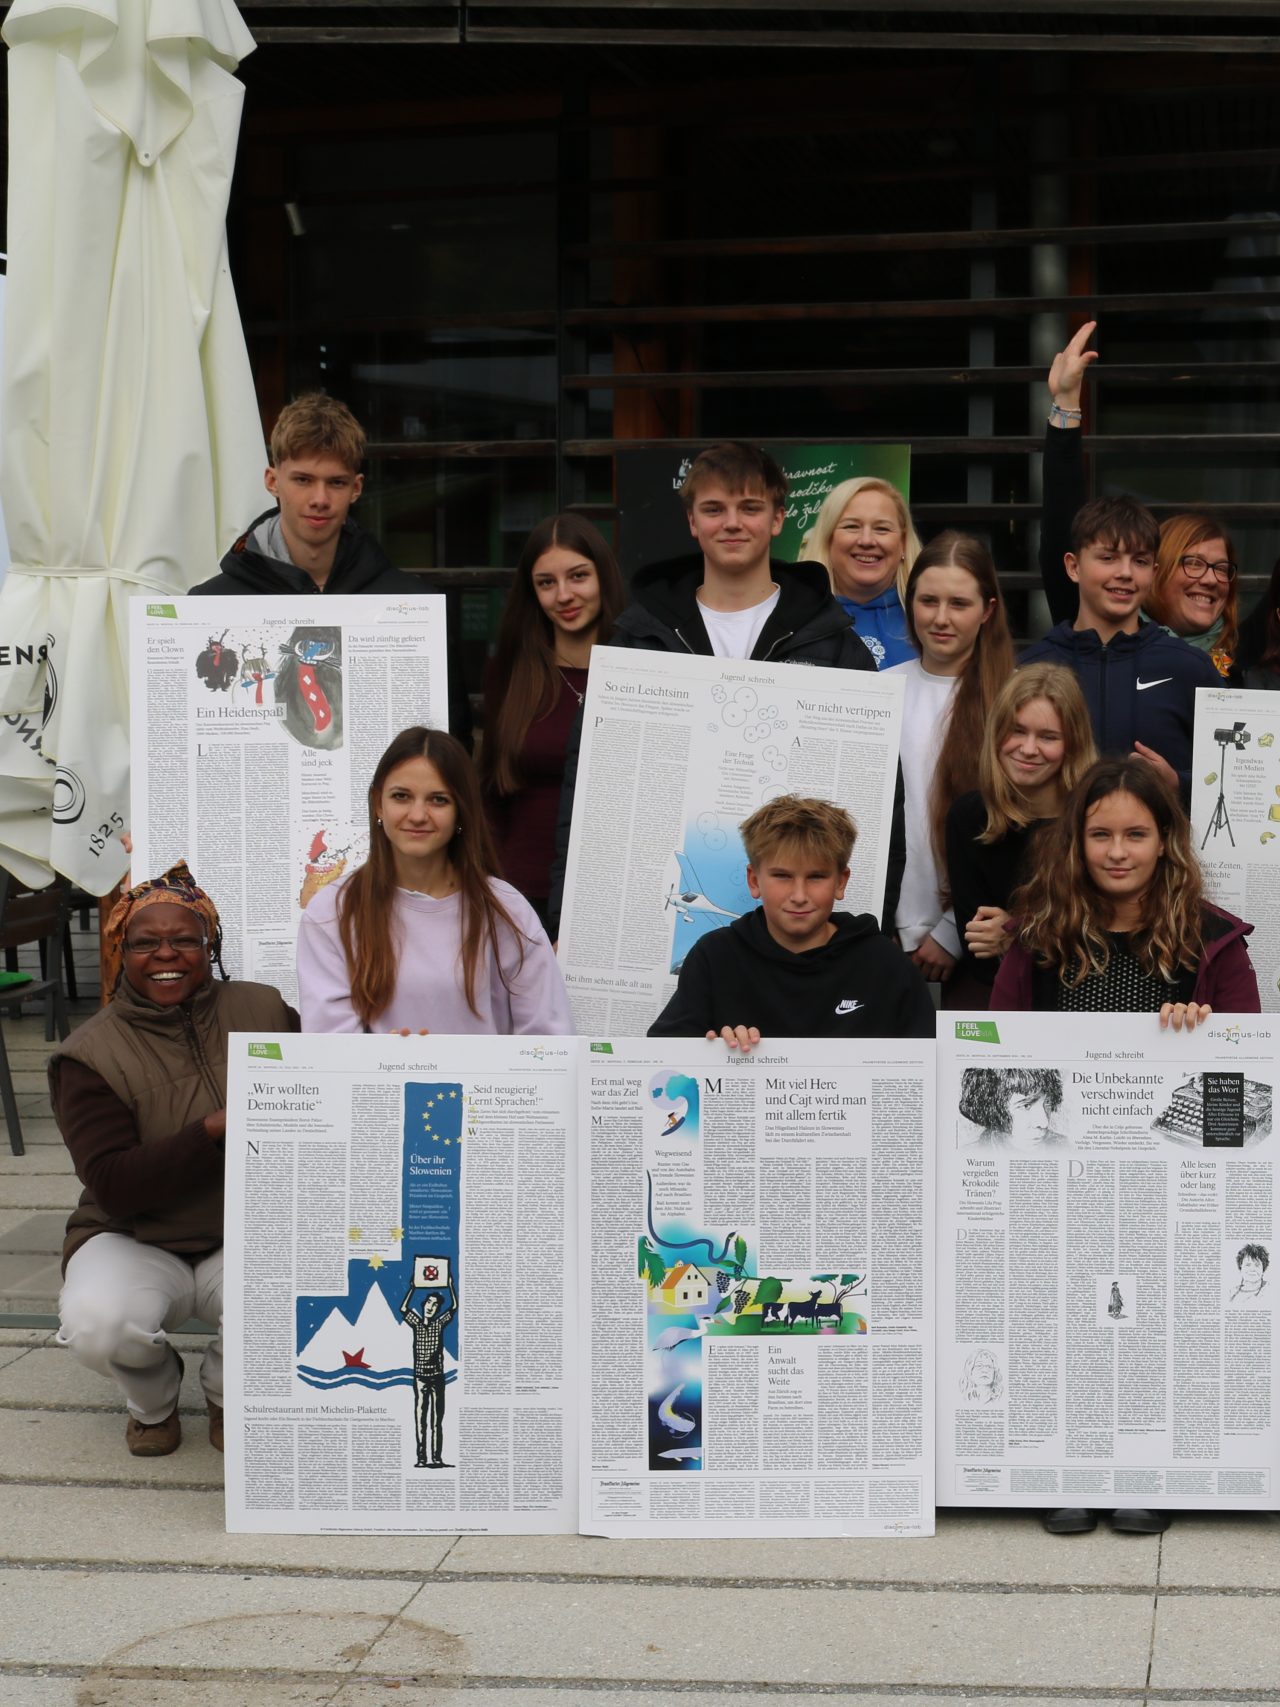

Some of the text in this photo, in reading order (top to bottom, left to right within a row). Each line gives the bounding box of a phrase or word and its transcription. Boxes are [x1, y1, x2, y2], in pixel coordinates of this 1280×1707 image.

[157, 637, 175, 645] spielt
[748, 675, 775, 684] schreibt
[605, 681, 689, 699] So ein Leichtsinn
[196, 707, 283, 719] Ein Heidenspaß
[796, 700, 891, 719] Nur nicht vertippen
[89, 811, 124, 857] 1825
[840, 1000, 858, 1008] NIKE
[726, 1056, 788, 1064] Jugend schreibt
[1085, 1051, 1144, 1060] Jugend schreibt
[378, 1062, 405, 1072] Jugend
[591, 1078, 607, 1086] Erst
[610, 1078, 624, 1086] mal
[1072, 1072, 1164, 1084] Die Unbekannte
[1208, 1077, 1240, 1086] Sie haben
[766, 1078, 837, 1089] Mit viel Herc
[248, 1083, 319, 1095] „Wir wollten
[469, 1085, 537, 1095] „Seid neugierig!
[608, 1088, 621, 1096] das
[624, 1088, 638, 1096] Ziel
[1208, 1086, 1238, 1094] das Wort
[1081, 1089, 1154, 1100] verschwindet
[248, 1099, 322, 1110] Demokratie“
[468, 1097, 493, 1106] Lernt
[765, 1094, 866, 1107] und Cajt wird man
[1082, 1104, 1153, 1116] nicht einfach
[765, 1110, 847, 1120] mit allem fertik
[655, 1150, 692, 1158] Wegweisend
[410, 1154, 445, 1164] Über ihr
[1180, 1161, 1216, 1169] Alle lesen
[409, 1166, 452, 1176] Slowenien
[963, 1169, 998, 1178] vergießen
[1180, 1171, 1216, 1179] über kurz
[962, 1179, 999, 1187] Krokodile
[1200, 1181, 1216, 1190] lang
[965, 1190, 996, 1198] Tränen?
[768, 1346, 782, 1354] Ein
[768, 1356, 796, 1365] Anwalt
[768, 1367, 804, 1375] sucht das
[244, 1405, 387, 1414] Schulrestaurant mit Michelin-Plakette
